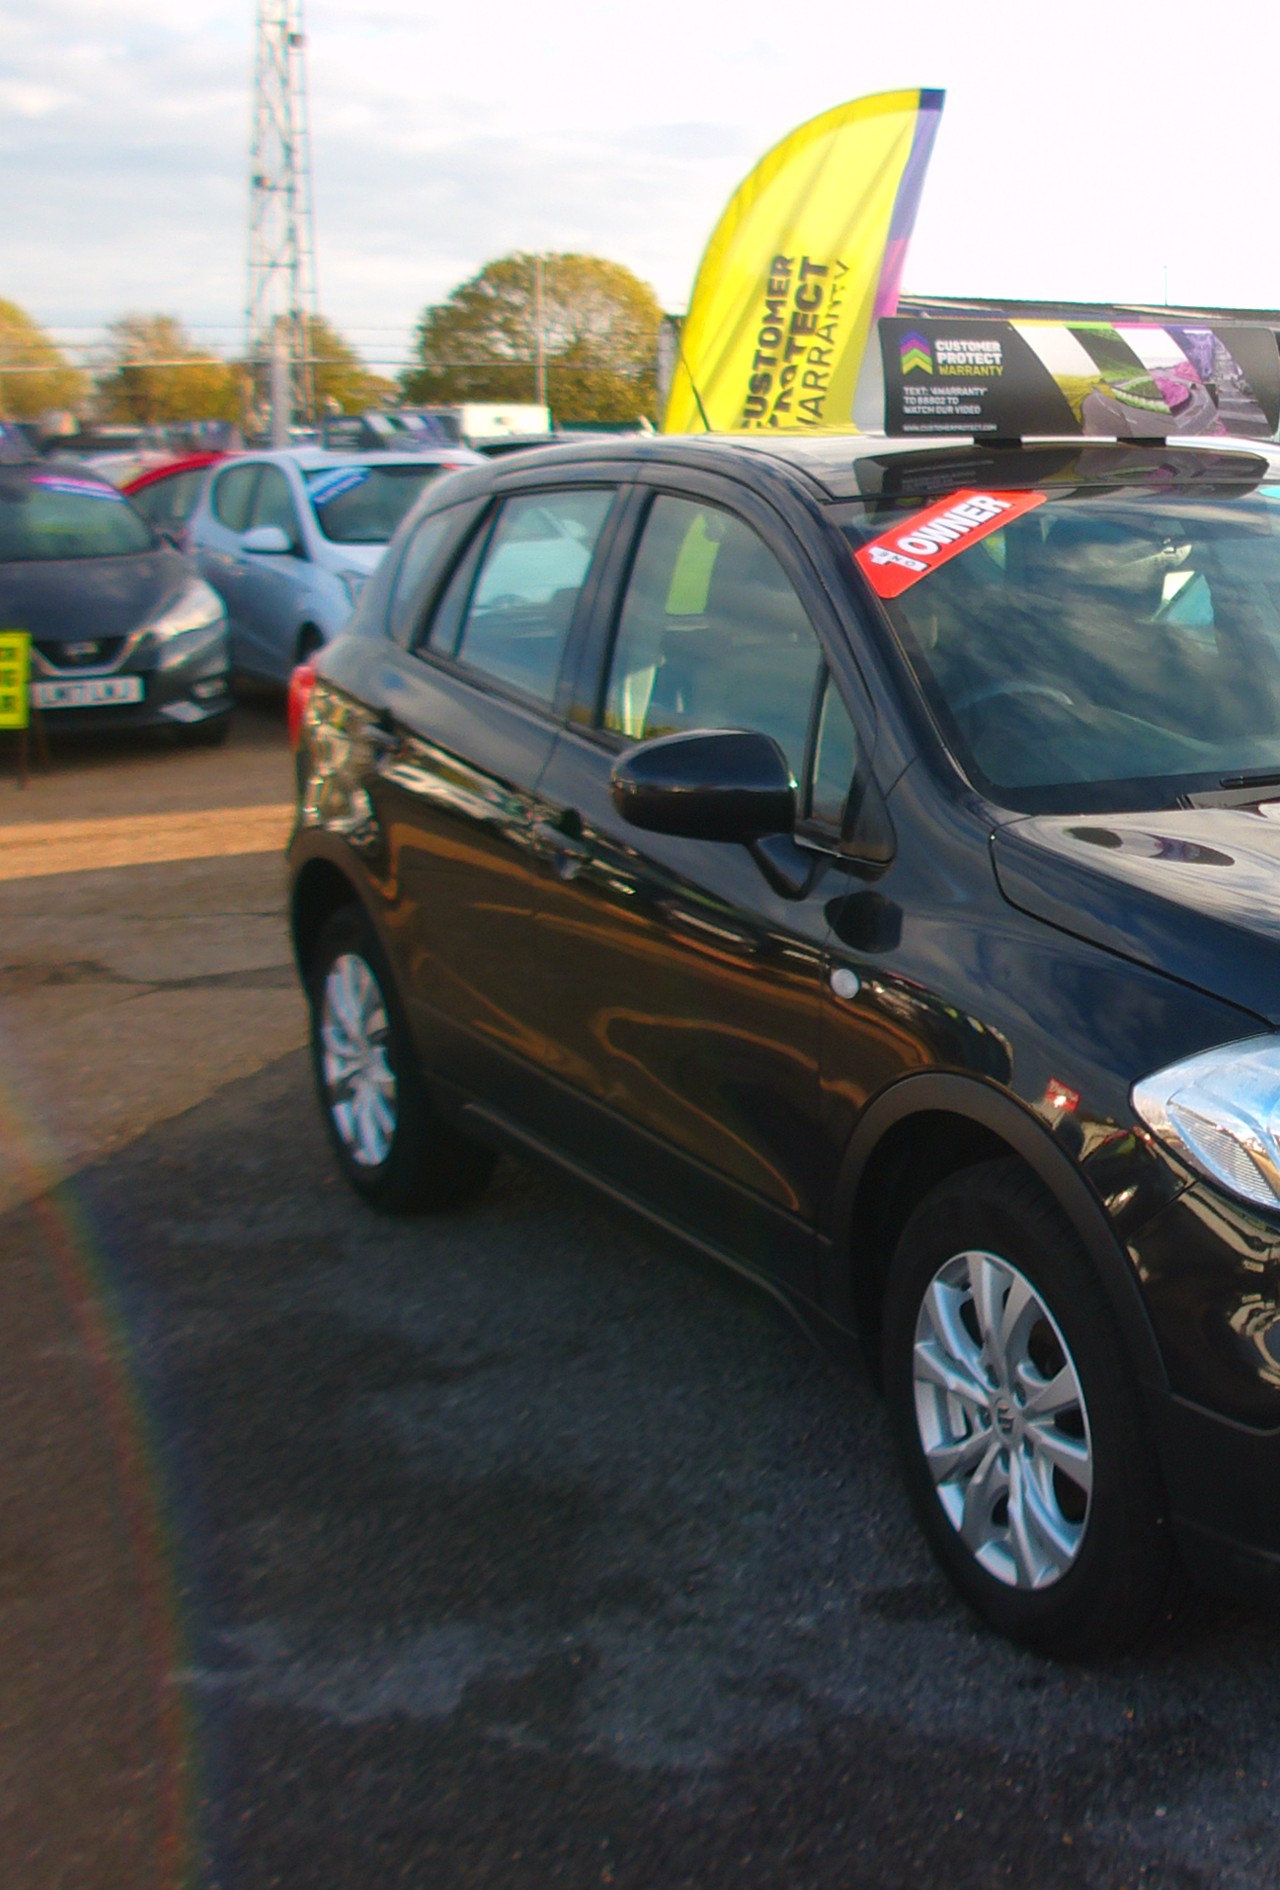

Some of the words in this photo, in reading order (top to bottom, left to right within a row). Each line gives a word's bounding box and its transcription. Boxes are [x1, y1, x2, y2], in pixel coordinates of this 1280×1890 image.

[741, 254, 795, 428] USTOMER
[935, 340, 1002, 351] CUSTOMER
[936, 352, 1003, 365] PROTECT
[938, 365, 1004, 376] WARRANTY
[903, 396, 916, 405] TO
[903, 405, 935, 414] WATCH
[936, 405, 954, 414] OUR
[954, 405, 982, 414] VIDEO
[897, 495, 1013, 556] OWNER
